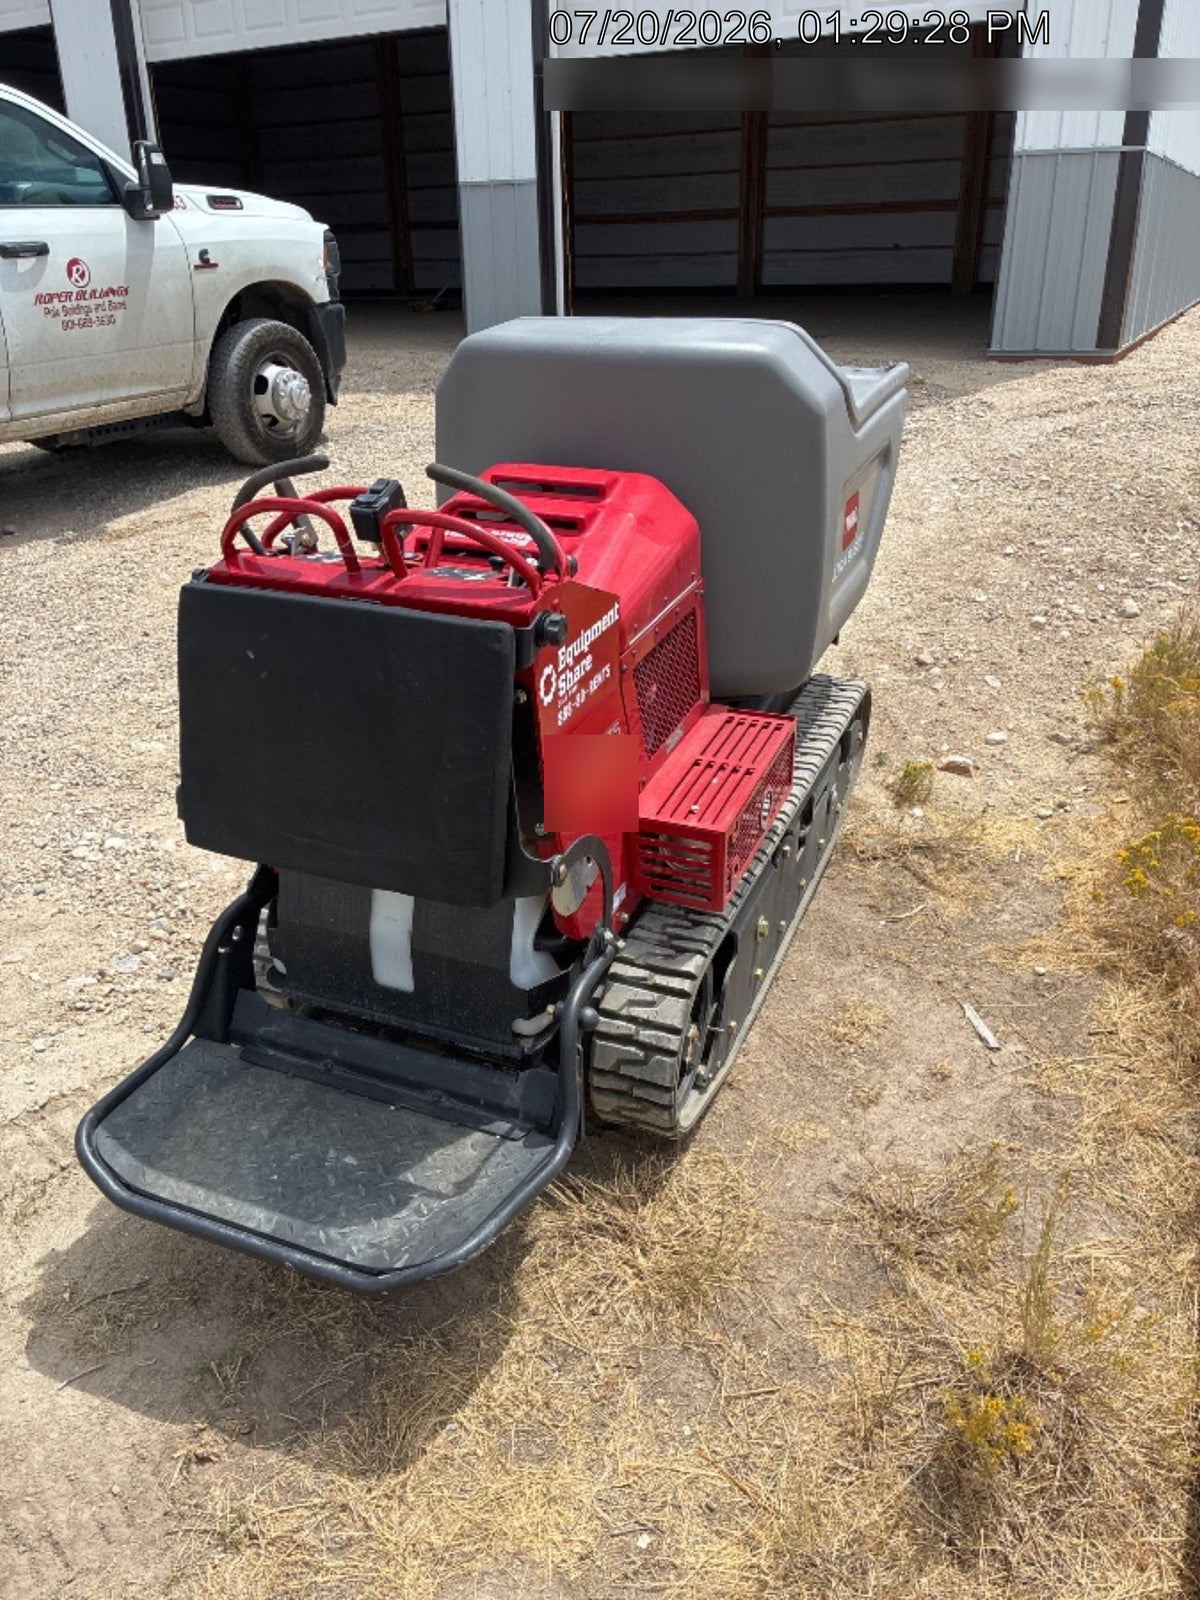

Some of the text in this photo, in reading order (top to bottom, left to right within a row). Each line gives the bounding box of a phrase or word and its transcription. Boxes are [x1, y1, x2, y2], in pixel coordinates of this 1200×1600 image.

[34, 291, 73, 306] ROPER
[558, 601, 620, 672] Equipment
[558, 653, 592, 698] Share
